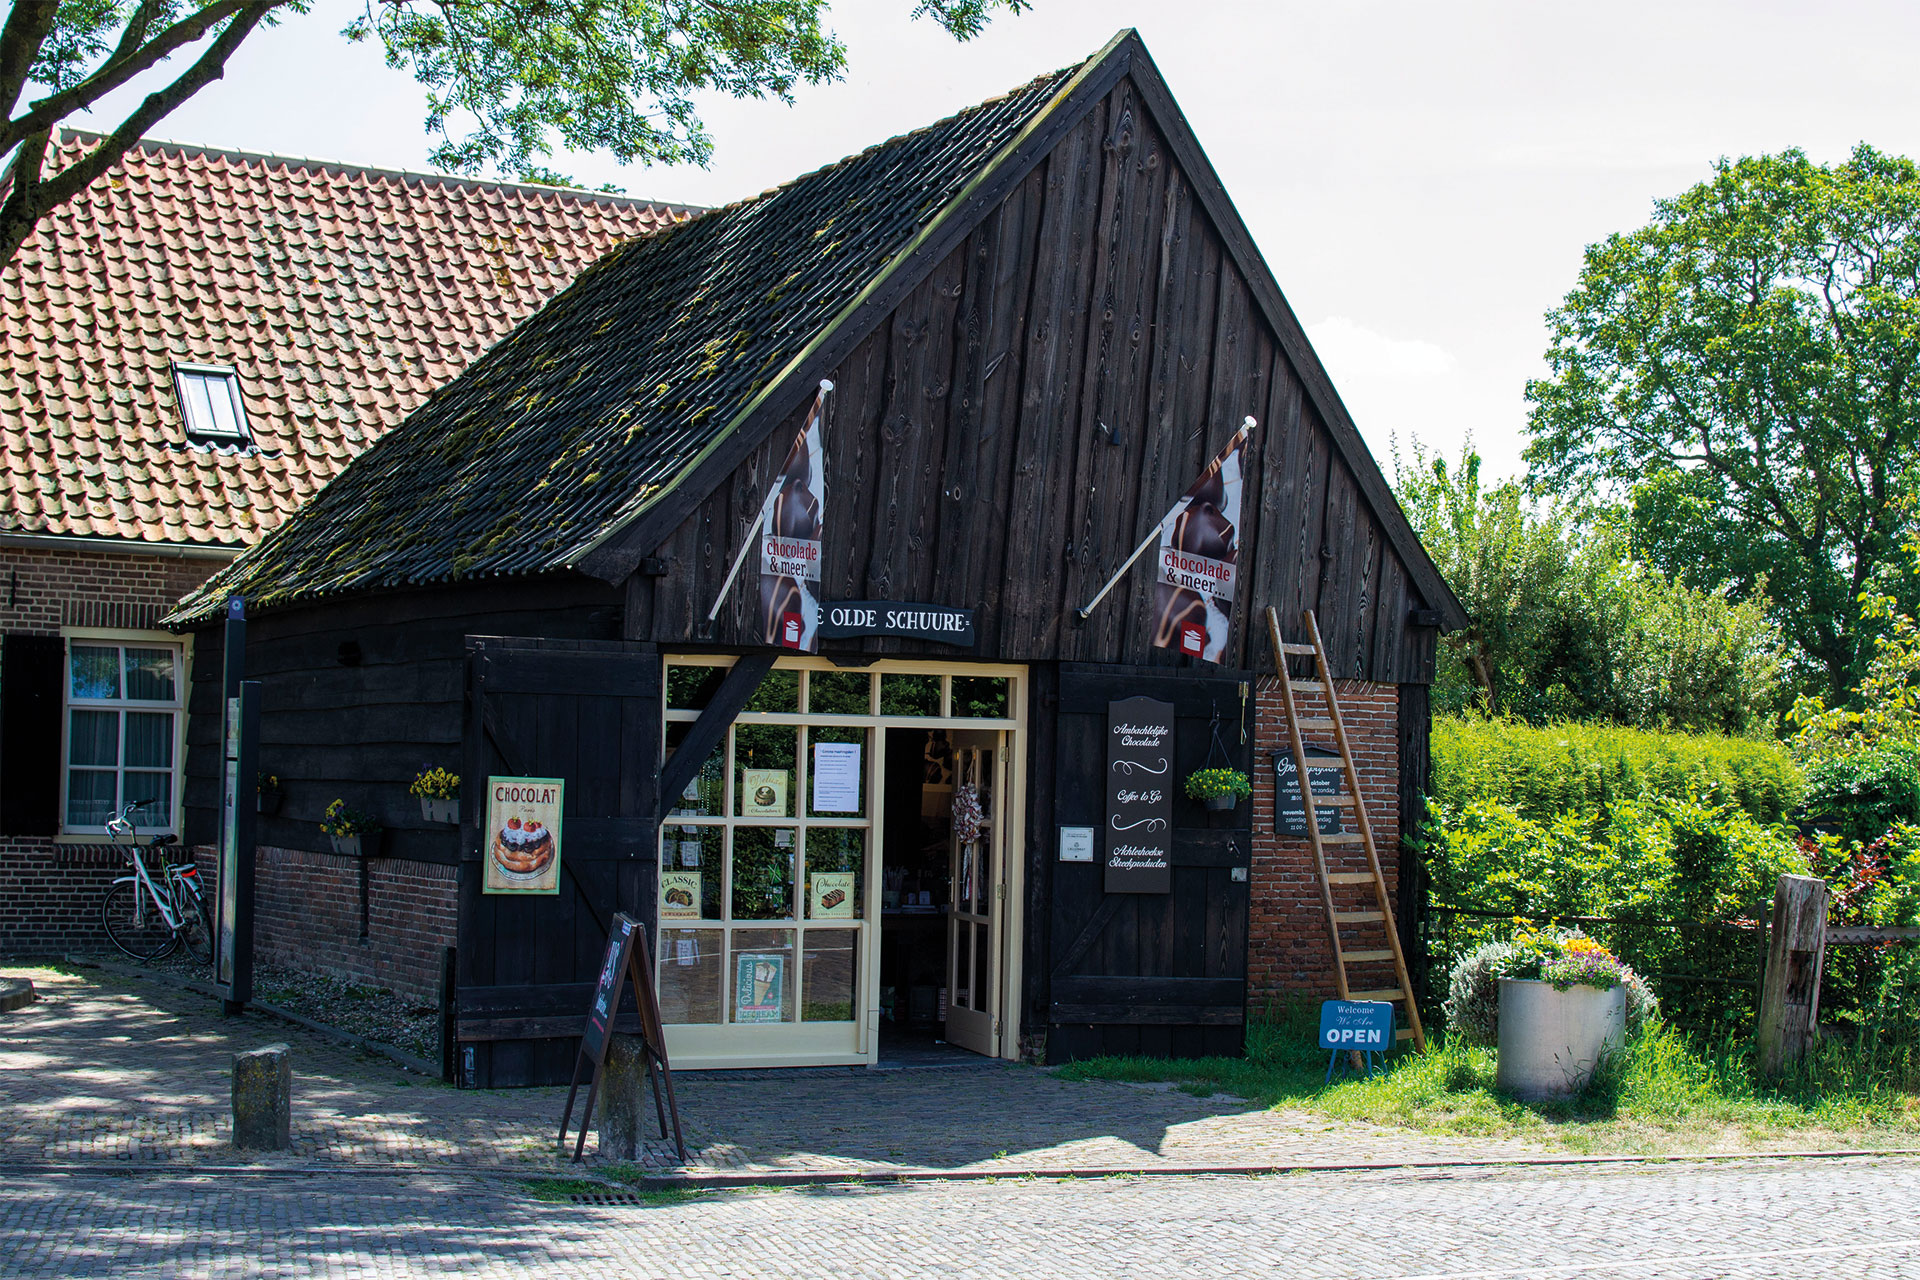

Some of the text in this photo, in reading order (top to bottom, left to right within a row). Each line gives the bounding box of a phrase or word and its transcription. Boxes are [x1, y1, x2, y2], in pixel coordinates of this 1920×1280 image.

[766, 539, 817, 560] chocolade
[769, 556, 814, 578] & meer...
[1164, 551, 1231, 582] chocolade
[1166, 567, 1226, 597] & meer...
[830, 608, 877, 627] OLDE
[1113, 723, 1169, 738] Ambachtelijke
[1121, 735, 1160, 747] Chocolade
[495, 786, 556, 803] CHOCOLAT
[1117, 789, 1162, 804] Coffee to Go
[661, 876, 698, 889] CLASSIC
[815, 877, 851, 894] Chocolate
[1337, 1005, 1374, 1014] Welcome
[1335, 1015, 1374, 1025] We Are
[1326, 1028, 1381, 1043] OPEN
